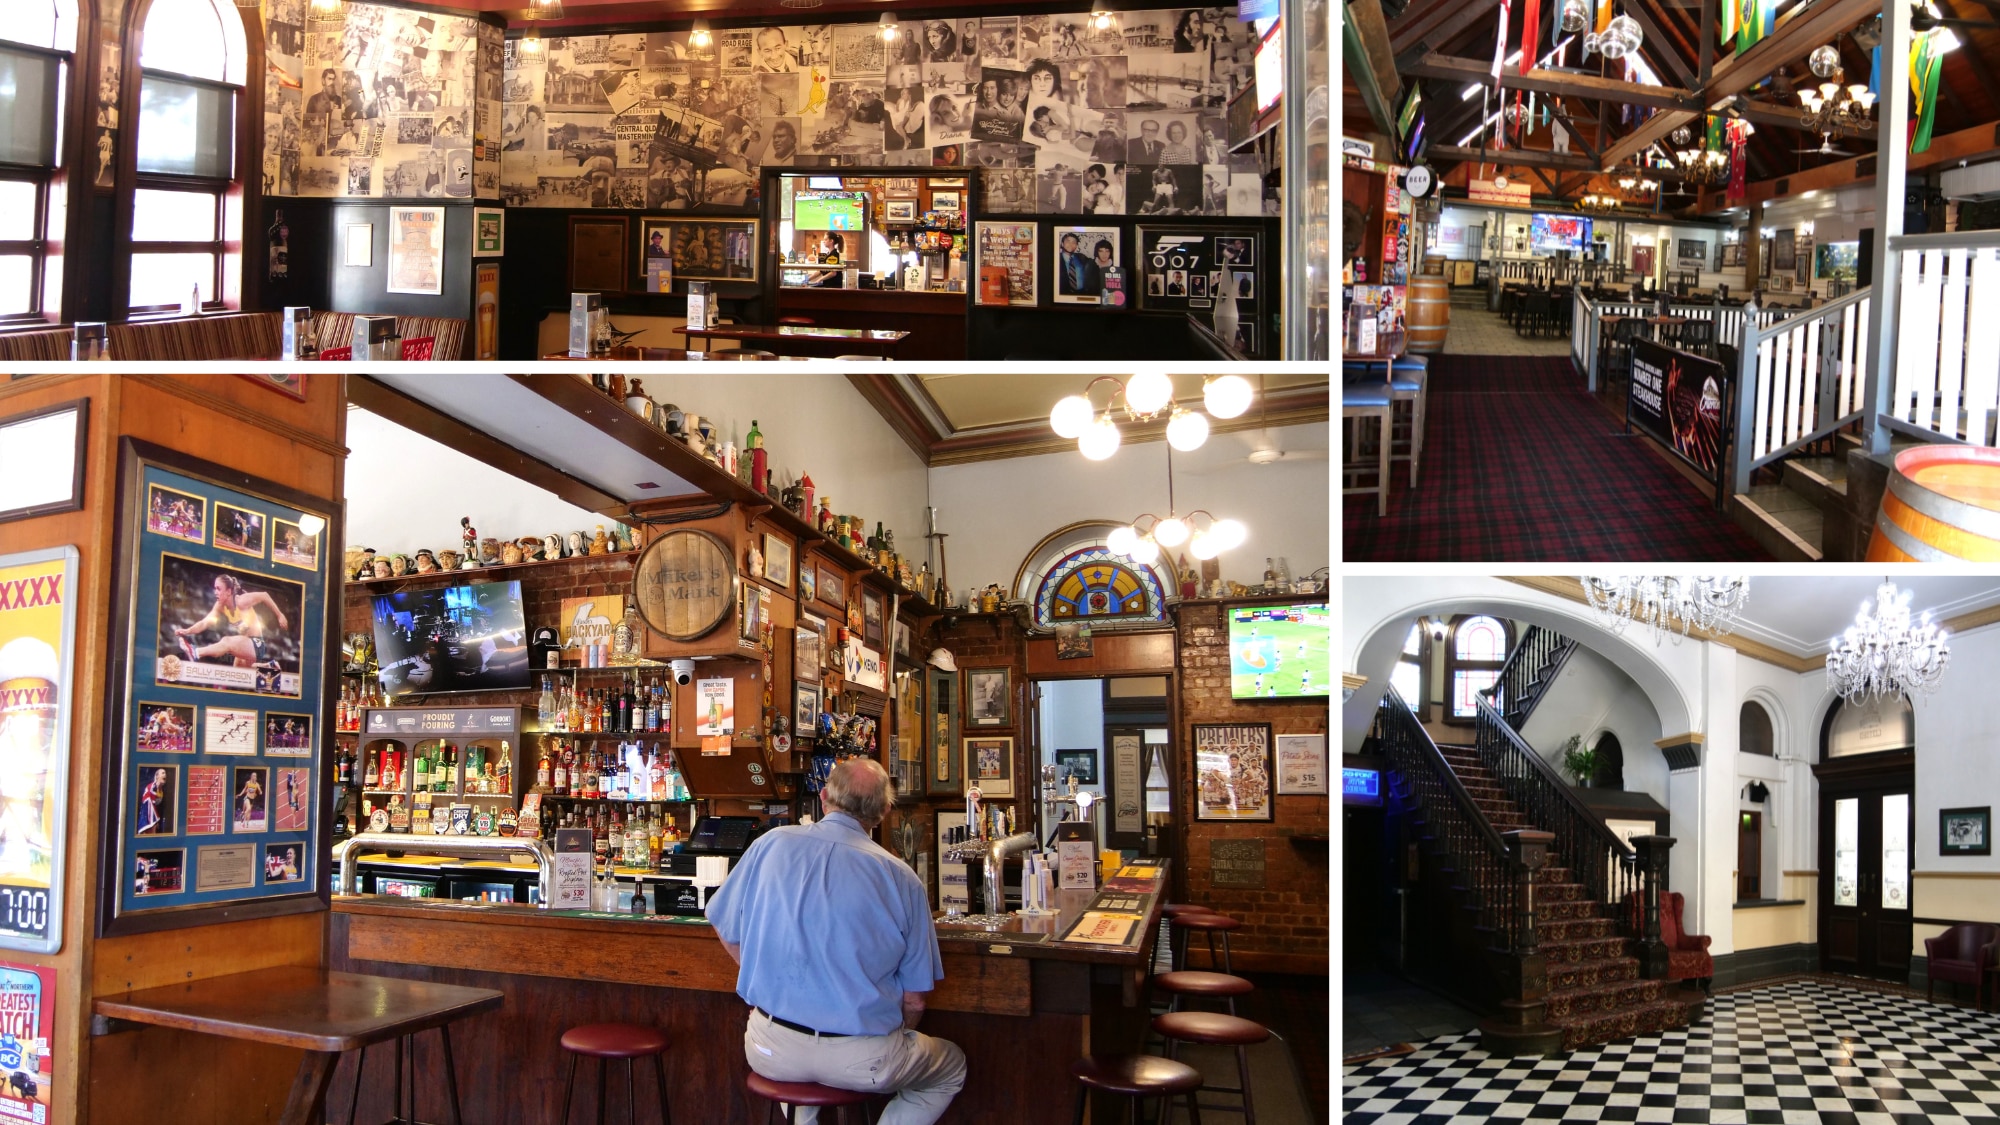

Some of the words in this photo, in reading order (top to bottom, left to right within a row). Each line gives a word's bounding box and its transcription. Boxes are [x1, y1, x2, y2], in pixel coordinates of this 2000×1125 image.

[721, 40, 738, 48] ROAD
[616, 125, 644, 133] CENTRAL
[1652, 375, 1662, 394] ONE
[186, 666, 213, 677] SALLY
[214, 669, 252, 681] PEARSON
[422, 713, 455, 721] PROUDLY
[421, 721, 456, 729] POURING
[1200, 728, 1265, 746] PREMIERS
[1303, 773, 1316, 781] $15
[479, 820, 489, 828] VB
[0, 992, 36, 1011] EATEST
[1, 1053, 19, 1065] BCF
